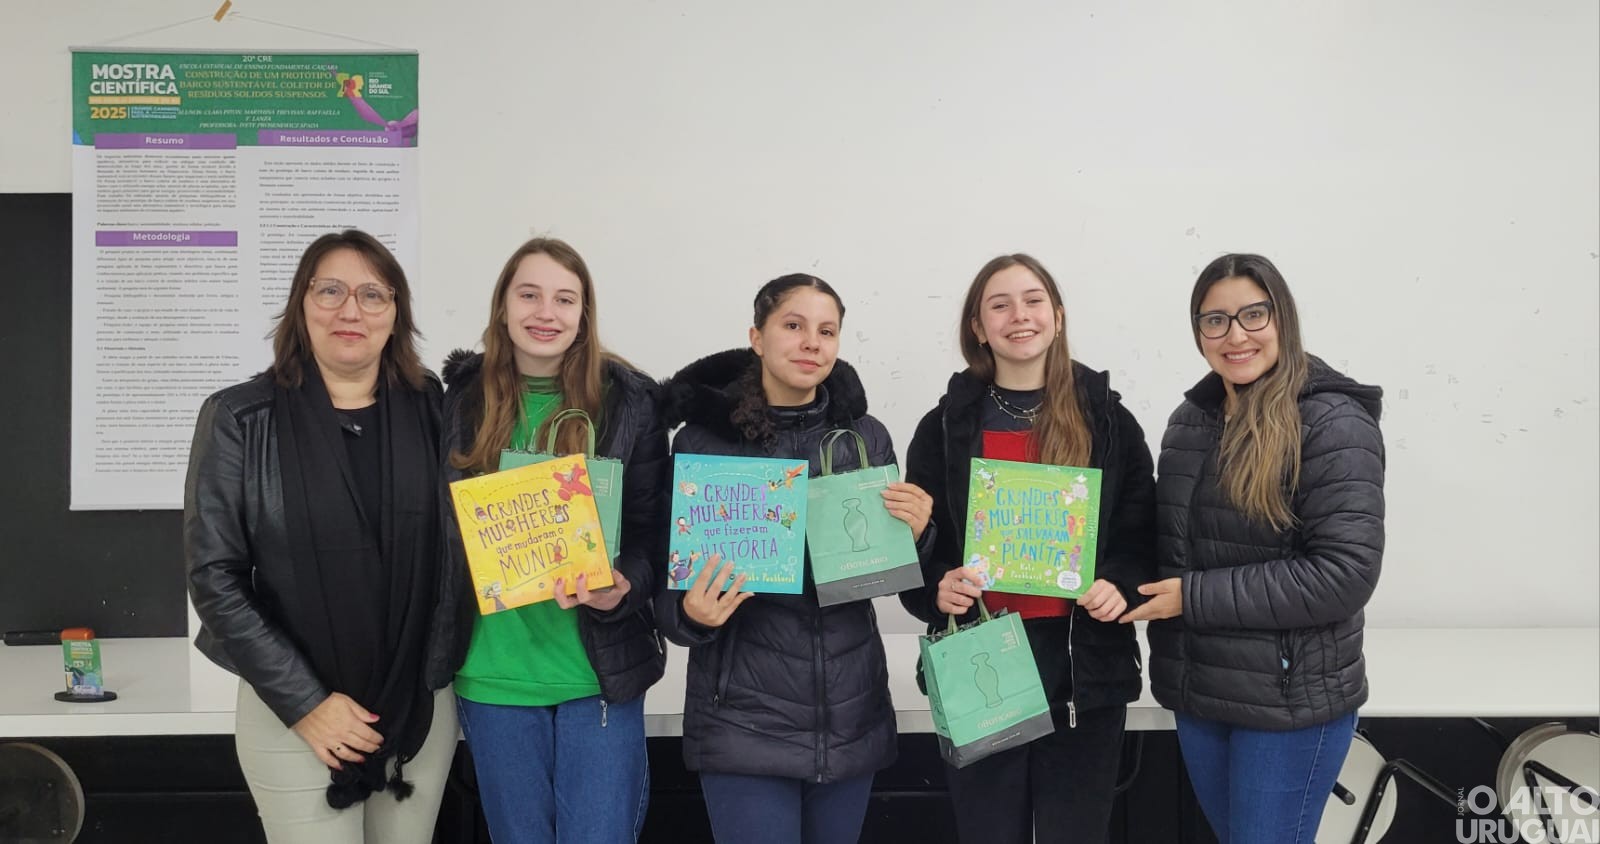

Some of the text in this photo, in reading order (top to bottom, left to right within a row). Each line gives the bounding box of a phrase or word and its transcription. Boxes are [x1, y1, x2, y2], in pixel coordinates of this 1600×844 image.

[92, 63, 176, 80] MOSTRA
[185, 70, 332, 80] CONSTRUÇÃO DE UM PROTÓTIPO
[90, 78, 179, 95] CIENTÍFICA
[180, 80, 337, 89] BARCO SUSTENTÁVEL COLETOR DE
[90, 106, 128, 119] 2025
[145, 136, 184, 145] Resumo
[280, 135, 331, 143] Resultados
[340, 135, 389, 144] Conclusão
[133, 232, 190, 242] Metodologia
[704, 523, 768, 539] que fizeram
[496, 527, 564, 558] que mudaram o
[701, 536, 779, 562] HISTÓRIA
[500, 538, 569, 585] MUNDO
[1002, 541, 1064, 567] PLANETA
